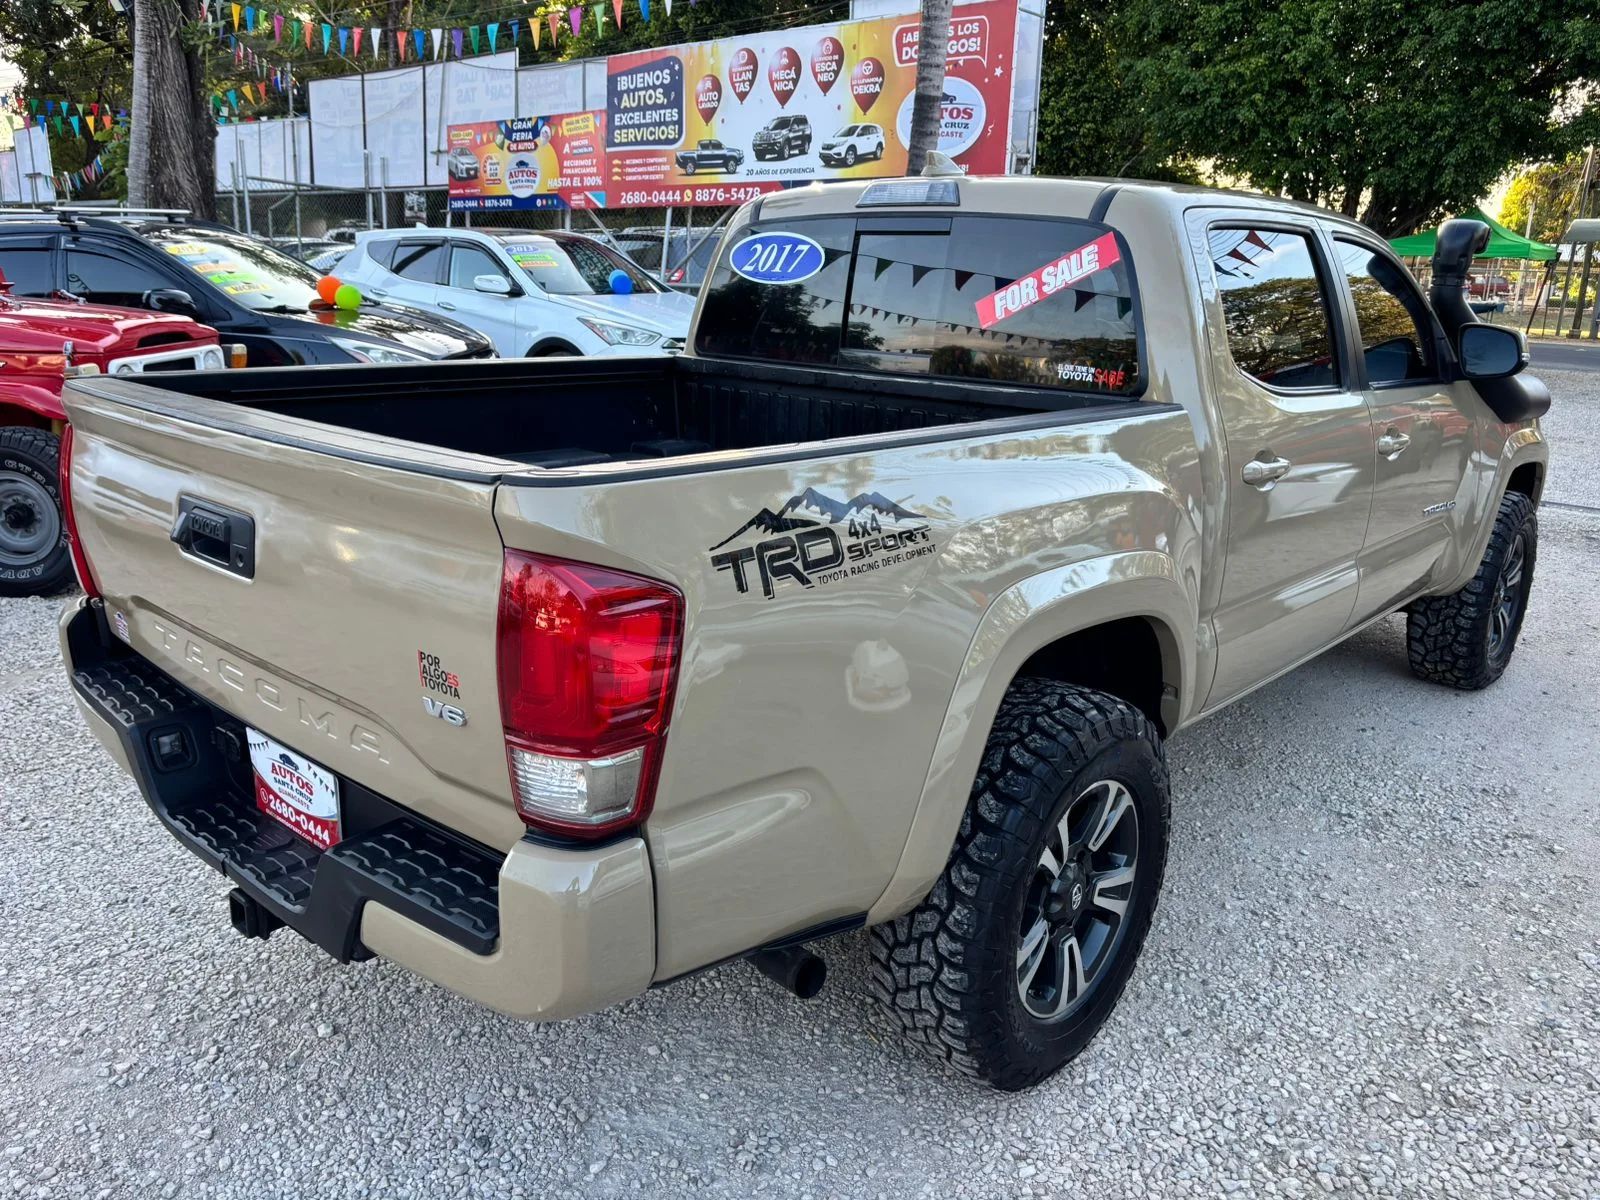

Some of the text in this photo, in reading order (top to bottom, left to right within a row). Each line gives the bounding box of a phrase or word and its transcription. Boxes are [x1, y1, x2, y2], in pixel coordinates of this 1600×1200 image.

[958, 22, 980, 35] LOS
[772, 67, 796, 81] MECÁ
[815, 62, 837, 72] ESCA
[616, 69, 671, 91] ¡BUENOS
[732, 71, 752, 83] LLAN
[774, 79, 795, 92] NICA
[817, 72, 834, 82] NEO
[698, 91, 719, 102] AUTO
[734, 82, 751, 93] TAS
[853, 84, 881, 95] DEKRA
[620, 88, 668, 109] AUTOS,
[698, 100, 719, 109] LAVADO
[512, 121, 532, 130] GRAN
[614, 108, 680, 126] EXCELENTES
[944, 122, 970, 130] CRUZ
[512, 130, 533, 140] FERIA
[614, 124, 680, 144] SERVICIOS!
[517, 142, 535, 150] AUTOS
[563, 144, 570, 154] A
[508, 170, 538, 179] AUTOS
[779, 166, 815, 175] EXPERIENCIA
[547, 176, 602, 187] HASTA EL 100%
[620, 186, 761, 204] 2680-0444 8876-5478
[741, 242, 812, 274] 2017
[994, 244, 1100, 320] FOR SALE
[1058, 368, 1125, 386] TOYOTA SABE
[190, 512, 224, 538] TOYOTA
[848, 512, 882, 540] 4x4
[710, 524, 932, 600] TRD SPORT
[818, 544, 937, 586] TOYOTA RACING DEVELOPMENT
[420, 650, 440, 669] POR
[154, 620, 391, 765] TACOMA
[422, 677, 461, 700] TOYOTA
[422, 696, 471, 728] V6
[271, 762, 314, 796] AUTOS
[273, 776, 313, 804] SANTA CRUZ
[268, 795, 330, 845] 2680-0444
